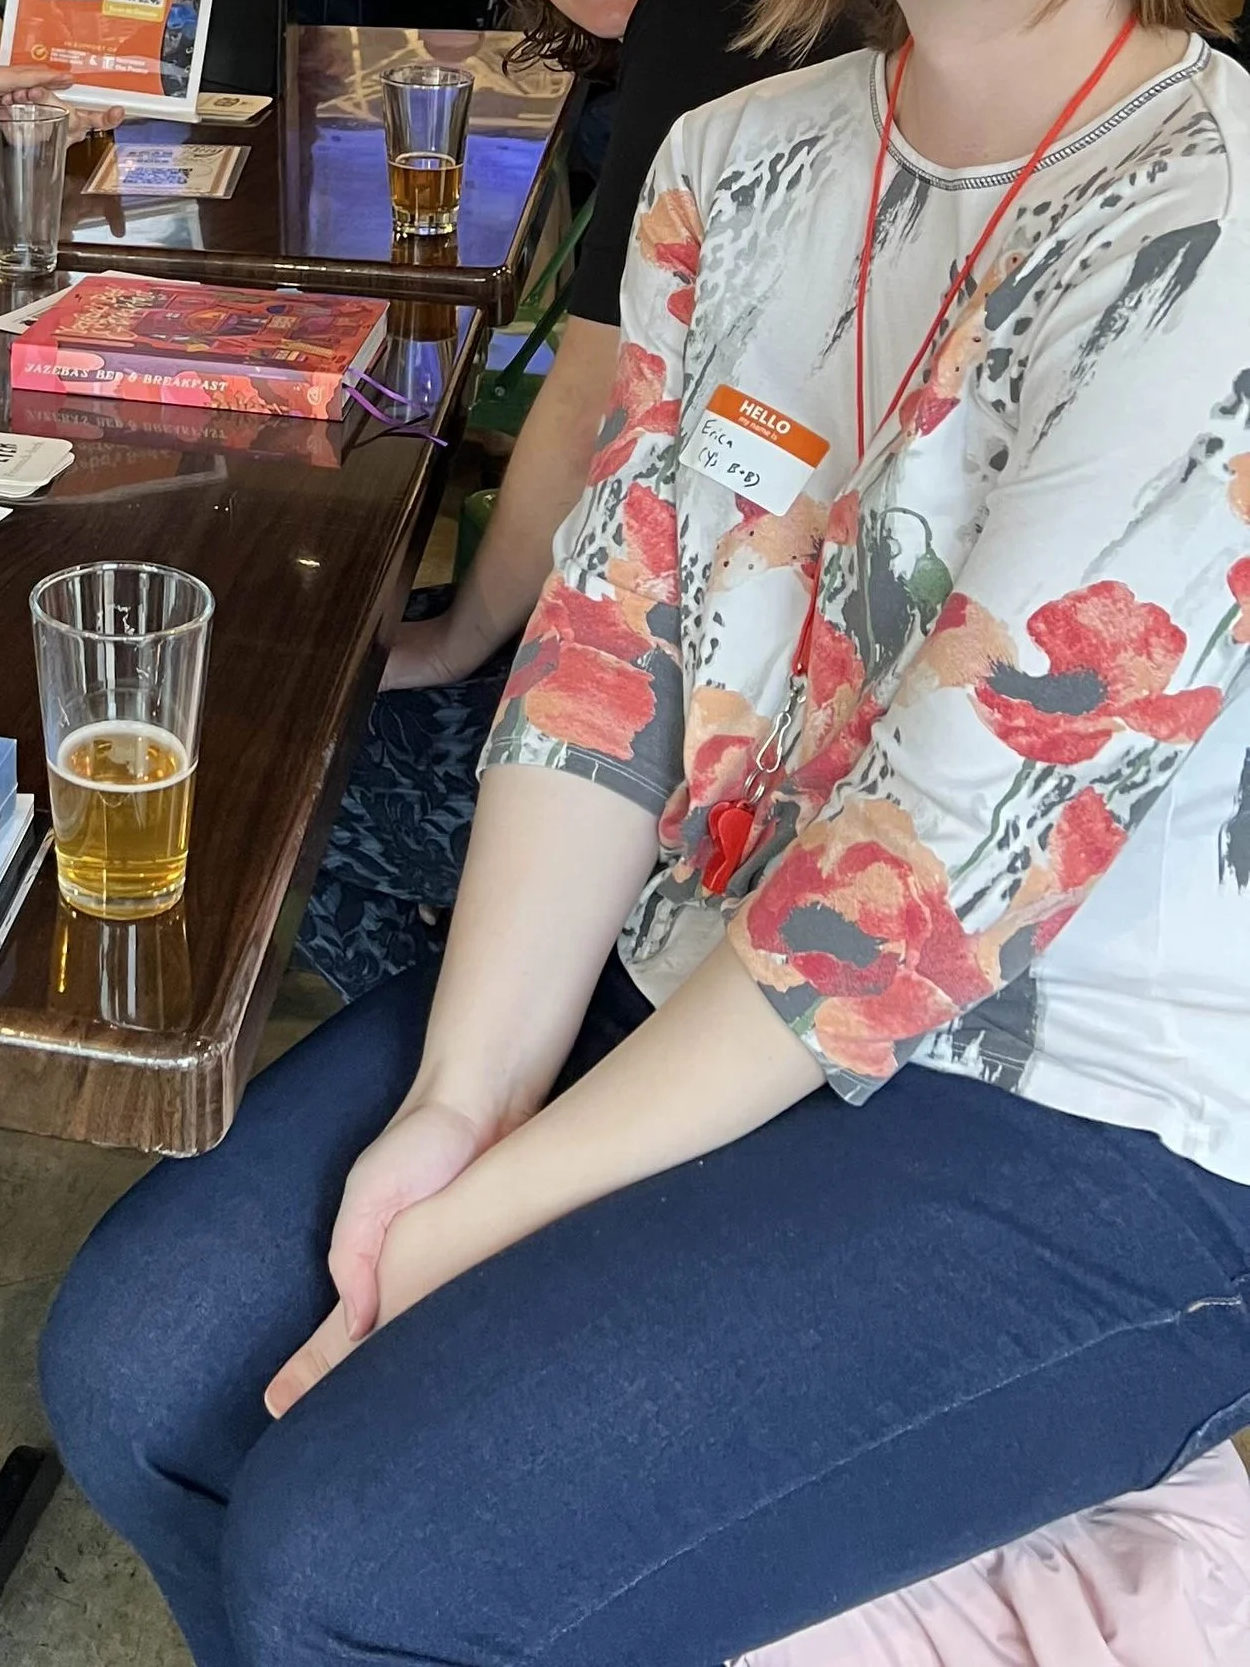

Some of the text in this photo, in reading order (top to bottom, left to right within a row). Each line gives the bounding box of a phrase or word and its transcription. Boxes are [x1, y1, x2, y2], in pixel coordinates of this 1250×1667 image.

[96, 368, 124, 383] BED
[143, 372, 229, 392] BREAKFAST
[737, 416, 750, 426] my
[749, 421, 771, 437] name
[739, 400, 792, 435] HELLO
